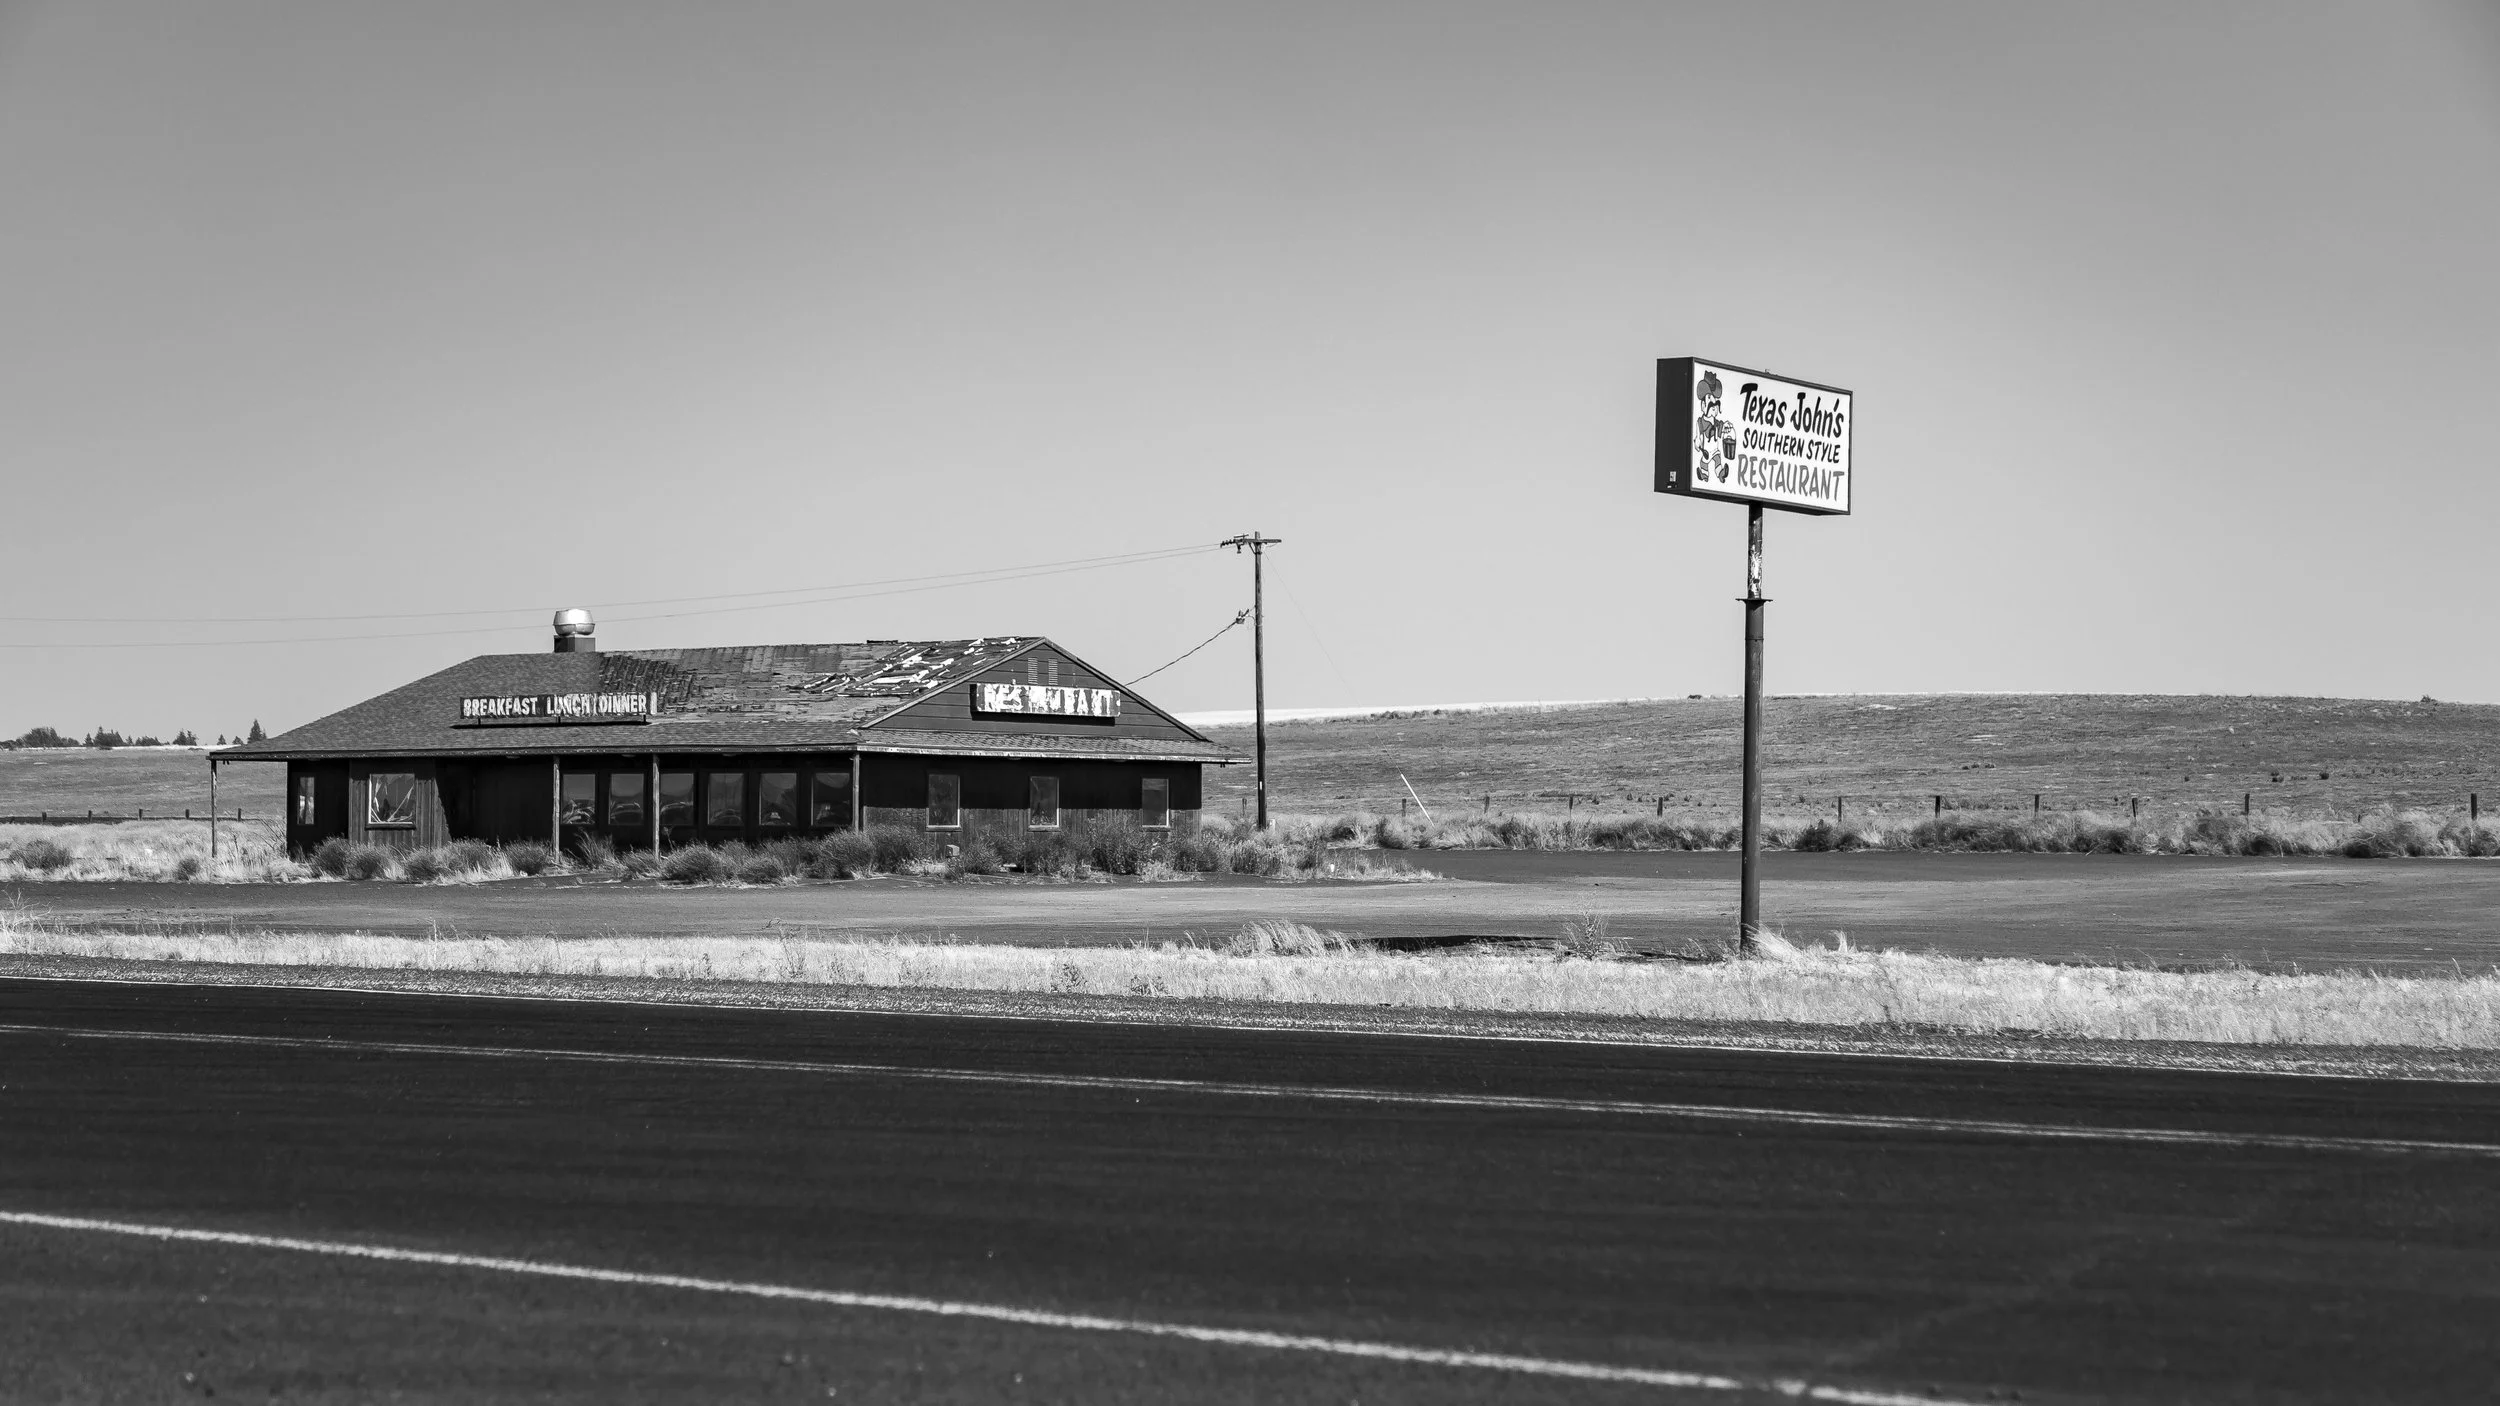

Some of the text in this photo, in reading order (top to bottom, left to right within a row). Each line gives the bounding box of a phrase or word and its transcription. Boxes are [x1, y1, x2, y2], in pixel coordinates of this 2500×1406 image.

[1739, 382, 1845, 439] Texas John's
[1742, 428, 1841, 464] SOUTHERN STYLE
[1737, 454, 1845, 501] RESTAURANT
[463, 694, 647, 717] BREAKFAST LUNCH DINNER
[983, 684, 1113, 717] RESURANT
